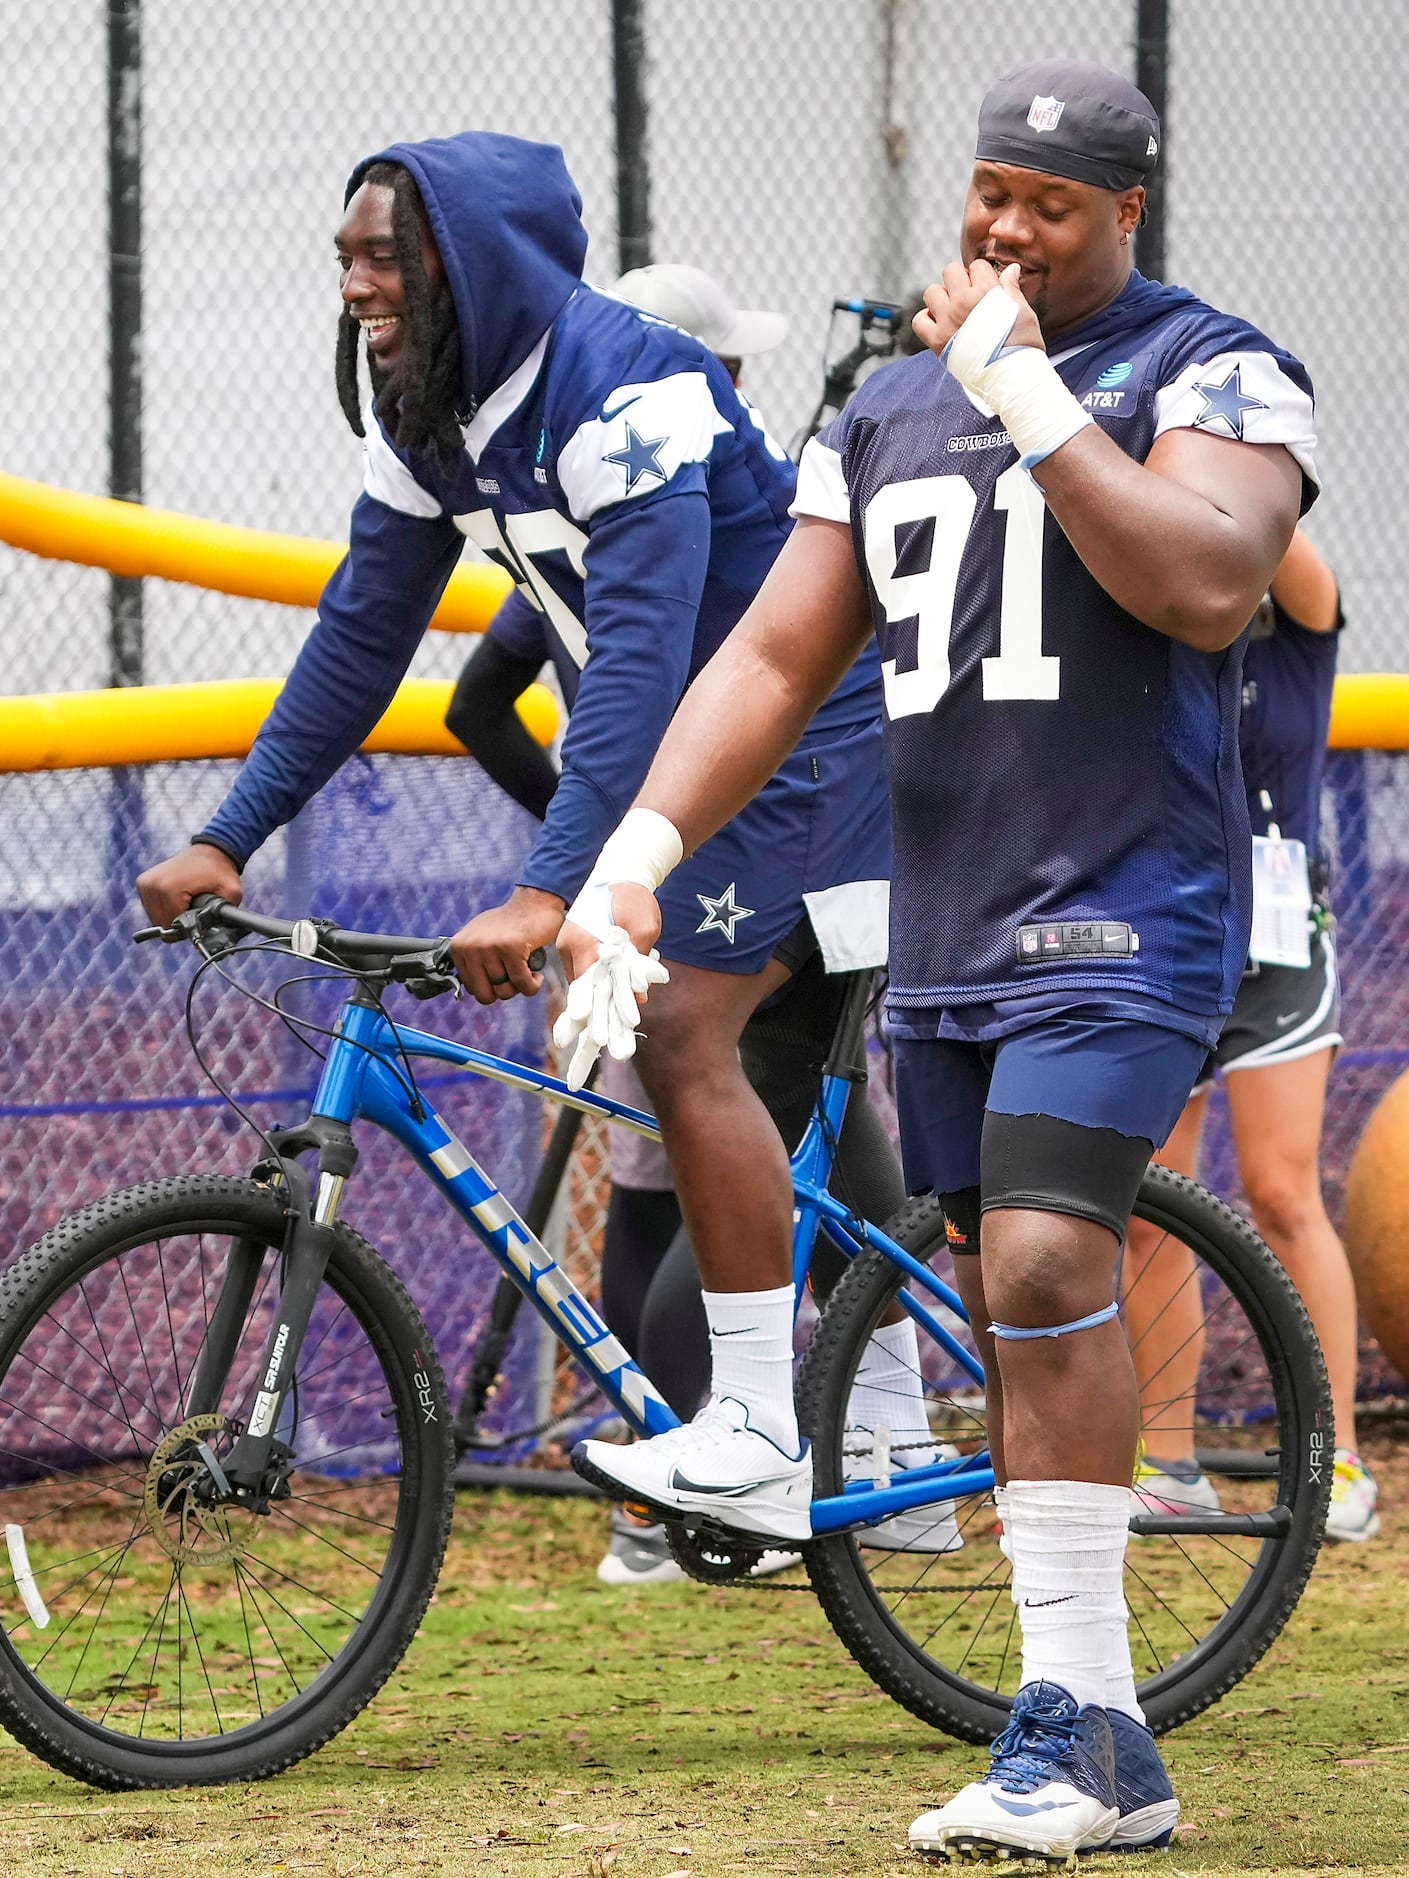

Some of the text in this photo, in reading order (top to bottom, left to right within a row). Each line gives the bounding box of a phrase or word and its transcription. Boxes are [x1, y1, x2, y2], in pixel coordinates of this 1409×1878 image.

[1032, 108, 1056, 127] NFL
[1080, 391, 1125, 408] AT&T
[865, 474, 1061, 722] 91
[1070, 927, 1094, 940] 54
[428, 1114, 670, 1425] TREK
[269, 1323, 290, 1372] SUNTOUR
[253, 1396, 269, 1432] XCT
[413, 1370, 438, 1424] XR2
[1307, 1431, 1324, 1484] XR2
